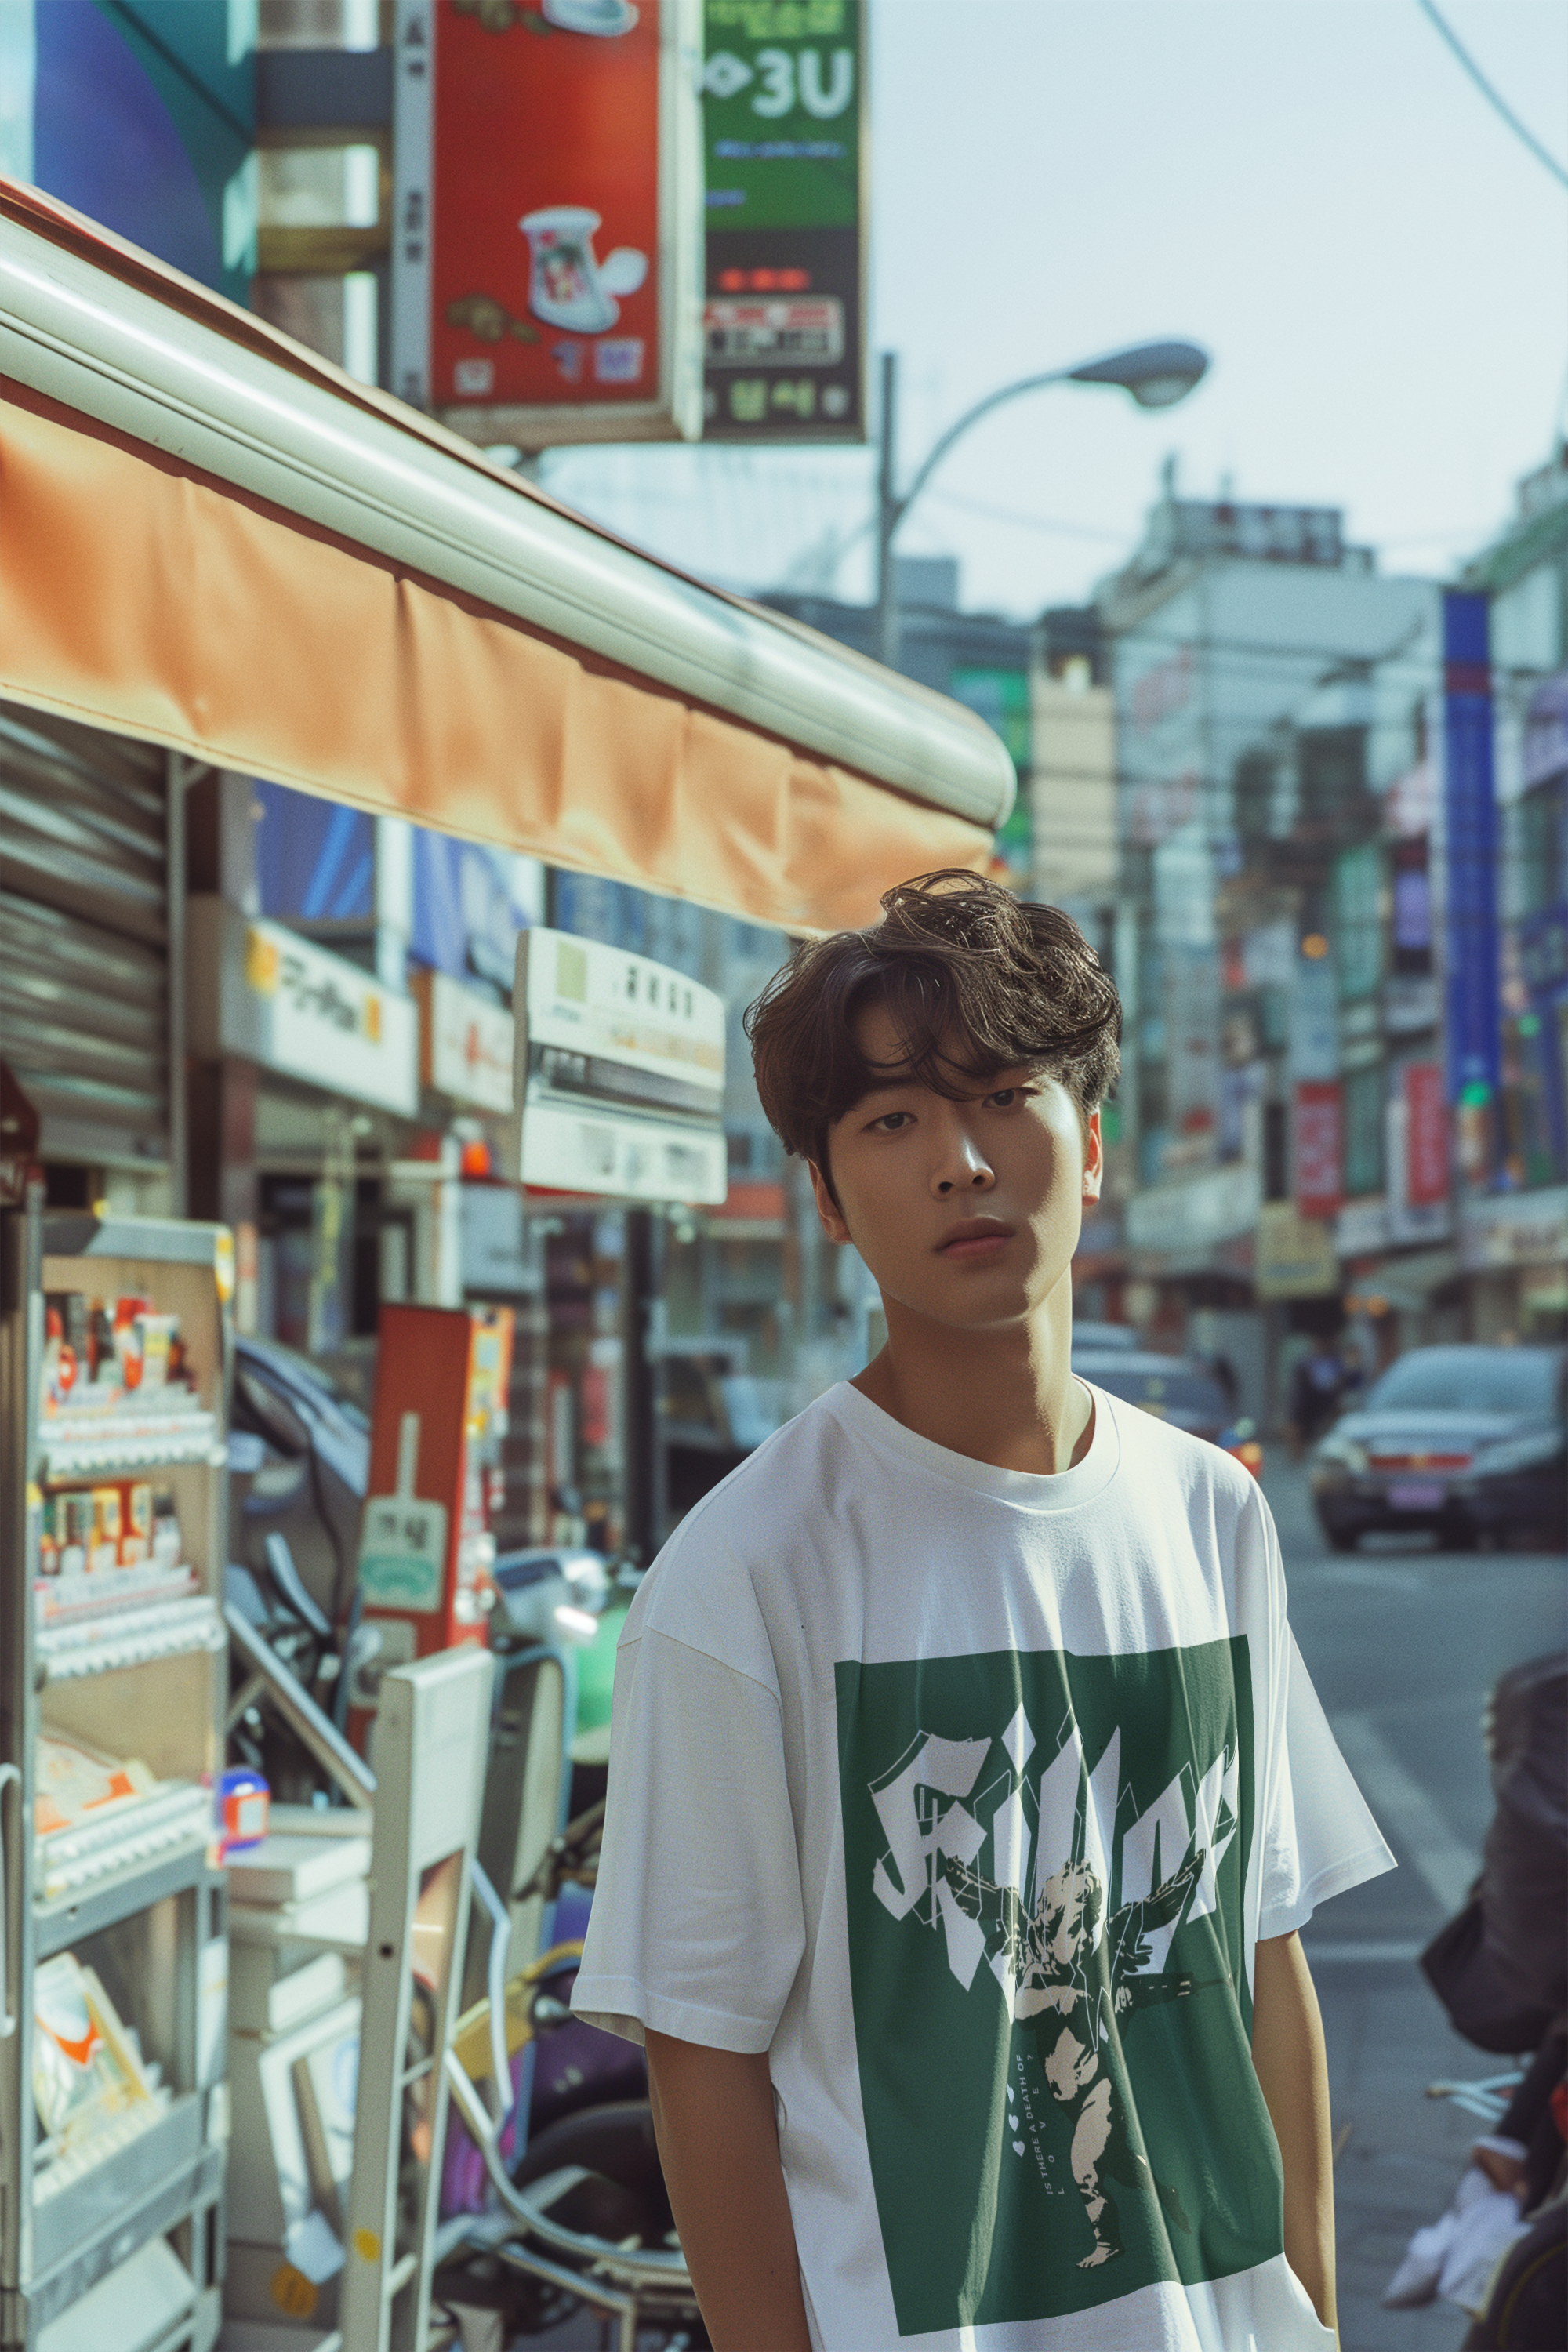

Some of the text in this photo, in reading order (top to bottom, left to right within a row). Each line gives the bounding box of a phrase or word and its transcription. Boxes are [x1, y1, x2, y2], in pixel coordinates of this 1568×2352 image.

[1016, 2054, 1054, 2195] IS THERE A DEATH OF
